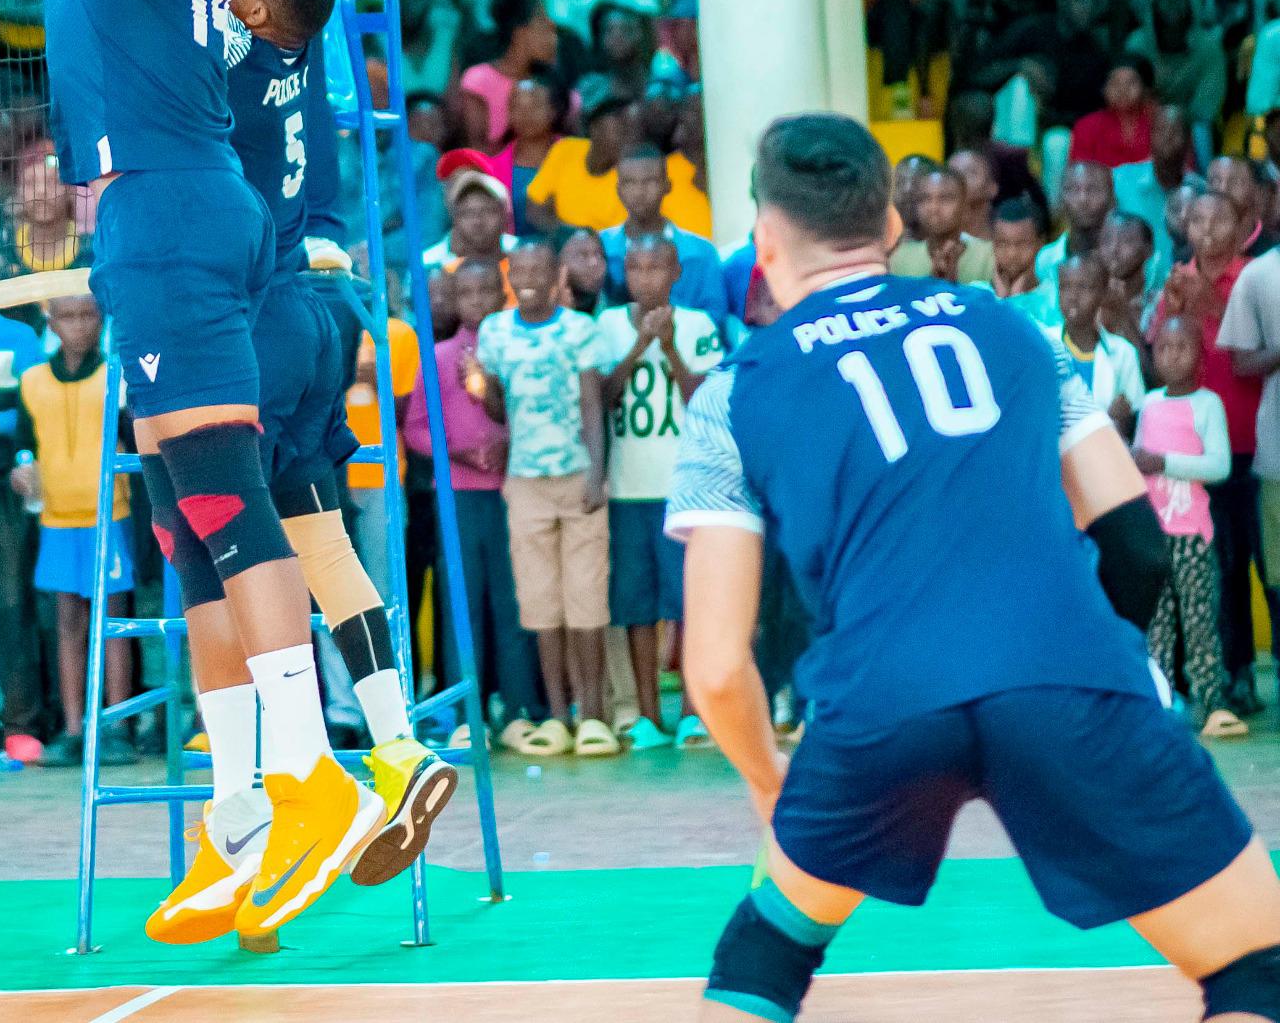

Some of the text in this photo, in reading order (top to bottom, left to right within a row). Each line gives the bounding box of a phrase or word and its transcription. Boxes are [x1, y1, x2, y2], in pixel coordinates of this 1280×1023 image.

[262, 72, 301, 107] POLICE
[282, 110, 307, 199] 5
[792, 292, 967, 354] POLICE VC
[836, 324, 1002, 464] 10
